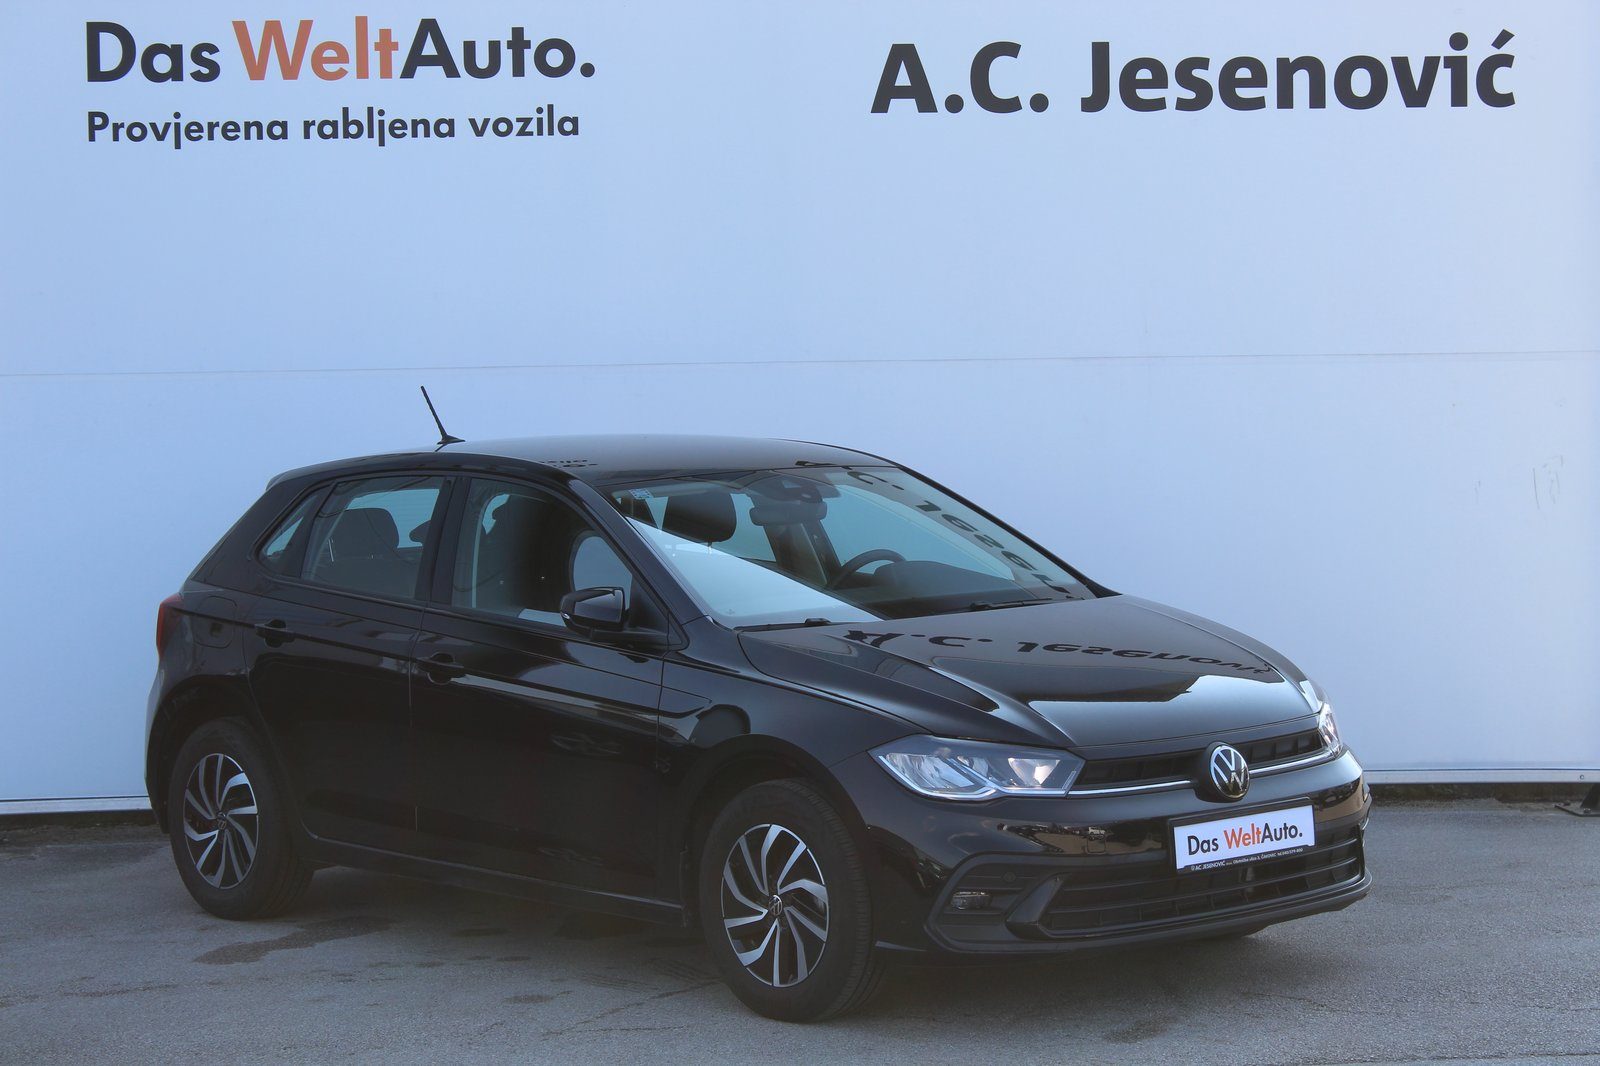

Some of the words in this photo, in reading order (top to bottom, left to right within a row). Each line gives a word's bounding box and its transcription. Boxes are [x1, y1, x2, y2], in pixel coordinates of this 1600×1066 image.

[86, 22, 220, 83] Das
[232, 16, 595, 80] WeltAuto.
[871, 42, 1049, 113] A.C.
[1081, 29, 1515, 112] Jesenović
[88, 112, 287, 149] Provjerena
[304, 107, 454, 146] rabljena
[468, 104, 578, 137] vozila
[1187, 835, 1219, 855] Das
[1224, 823, 1303, 849] WeltAuto.
